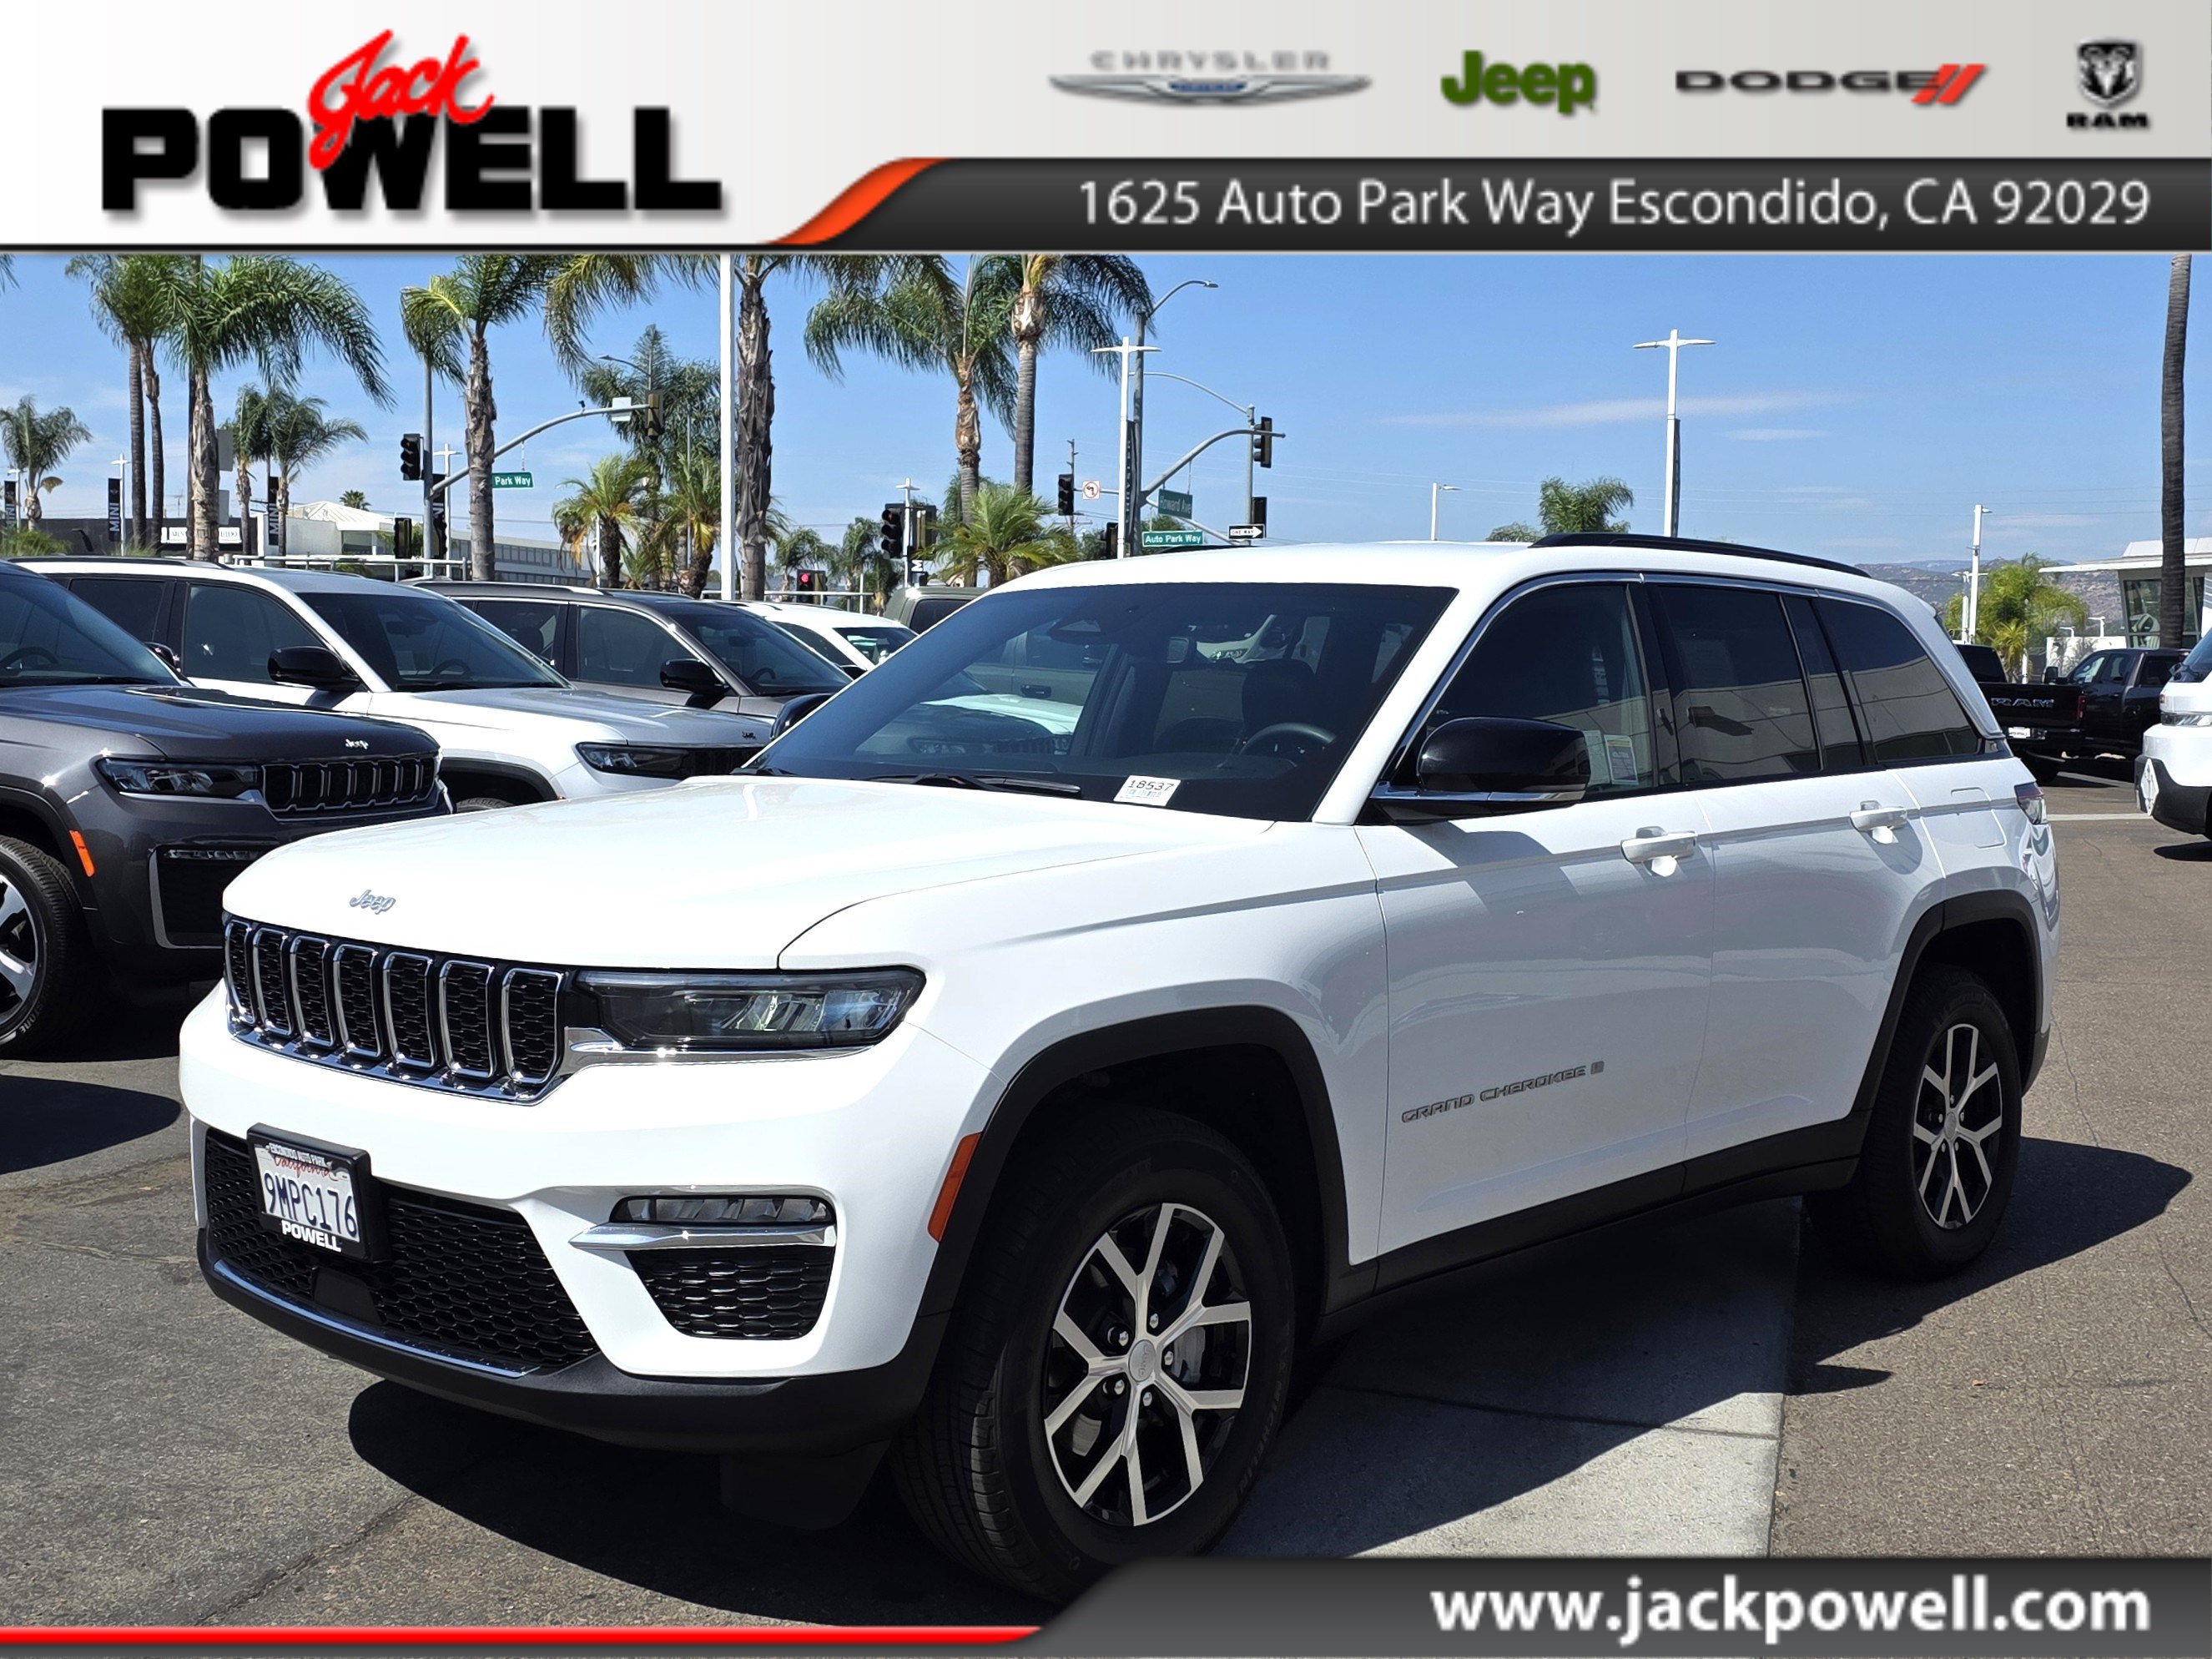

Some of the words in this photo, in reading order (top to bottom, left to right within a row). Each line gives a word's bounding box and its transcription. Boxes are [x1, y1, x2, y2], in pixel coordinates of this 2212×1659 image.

[495, 477, 512, 485] Park
[514, 476, 532, 486] Way
[109, 502, 120, 532] MINI
[1145, 534, 1163, 543] Auto
[1165, 533, 1183, 542] Park
[1185, 532, 1202, 543] Way
[1991, 698, 2054, 708] RAM
[1128, 780, 1175, 791] 18537
[350, 890, 396, 915] Jeep
[1402, 1094, 1475, 1122] GRAND
[1480, 1066, 1586, 1102] CHEROKEE
[265, 1172, 357, 1238] 9MPC176
[281, 1219, 341, 1253] POWELL
